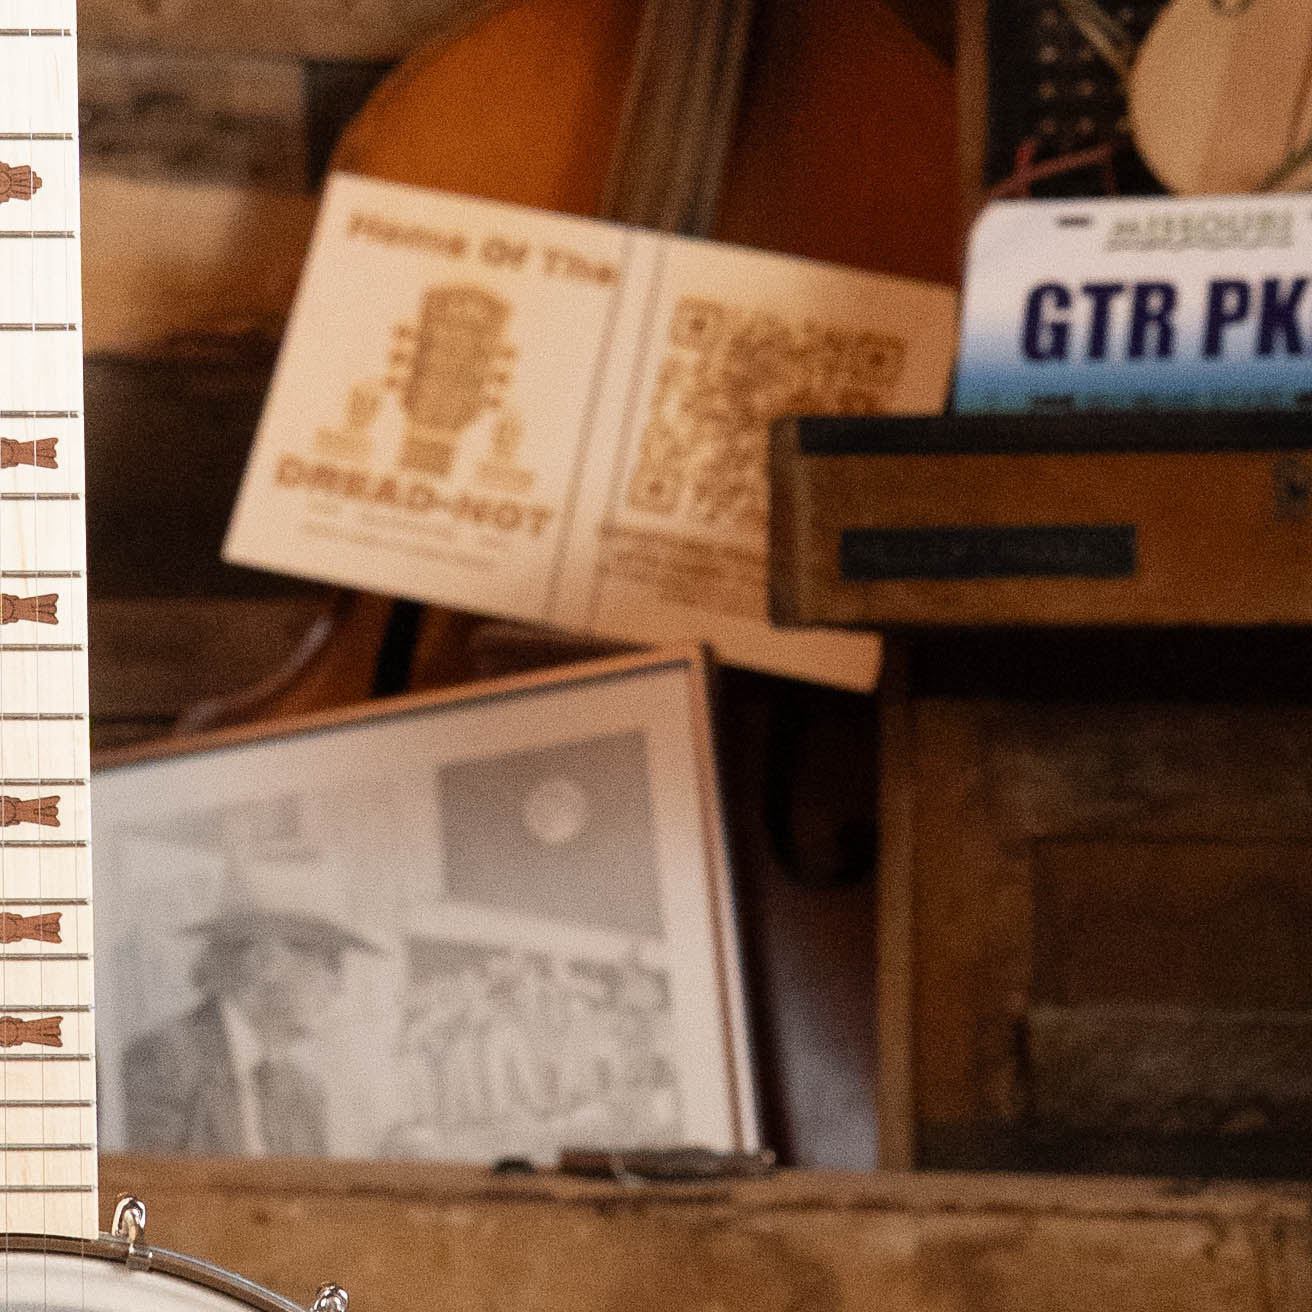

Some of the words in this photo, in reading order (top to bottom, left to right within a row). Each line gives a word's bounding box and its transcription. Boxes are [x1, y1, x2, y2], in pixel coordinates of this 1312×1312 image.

[1022, 280, 1178, 364] GTR
[1202, 277, 1310, 361] PK
[274, 451, 553, 536] DREAD-NOT
